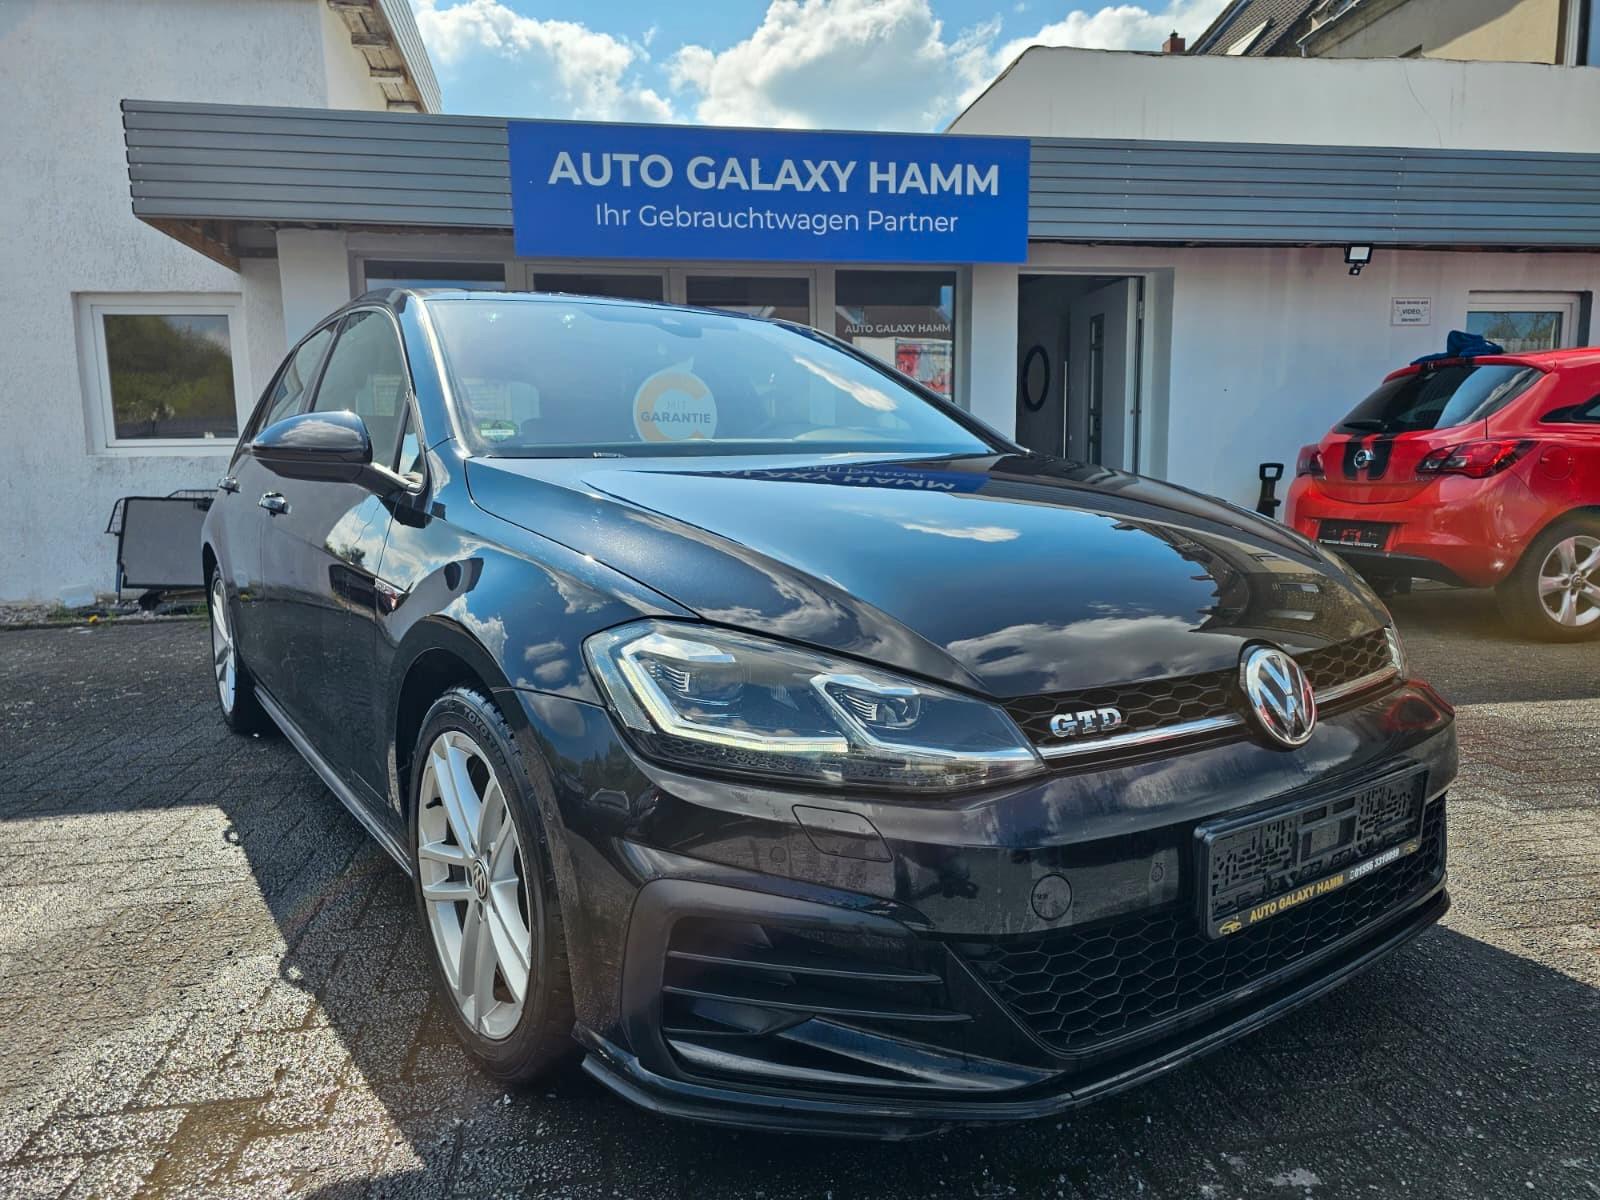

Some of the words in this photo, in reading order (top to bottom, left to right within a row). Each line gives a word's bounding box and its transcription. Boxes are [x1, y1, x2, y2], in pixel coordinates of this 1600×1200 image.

[548, 151, 673, 189] AUTO
[686, 155, 858, 193] GALAXY
[869, 161, 999, 196] HAMM
[596, 203, 630, 227] Ihr
[639, 204, 860, 236] Gebrauchtwagen
[867, 211, 959, 233] Partner
[844, 324, 874, 334] AUTO
[875, 324, 916, 334] GALAXY
[918, 324, 951, 333] HAMM
[641, 411, 712, 424] GARANTIE
[1050, 707, 1122, 738] GTD
[1250, 902, 1277, 923] AUTO
[1278, 885, 1315, 909] GALAXY
[1317, 874, 1344, 895] HAMM
